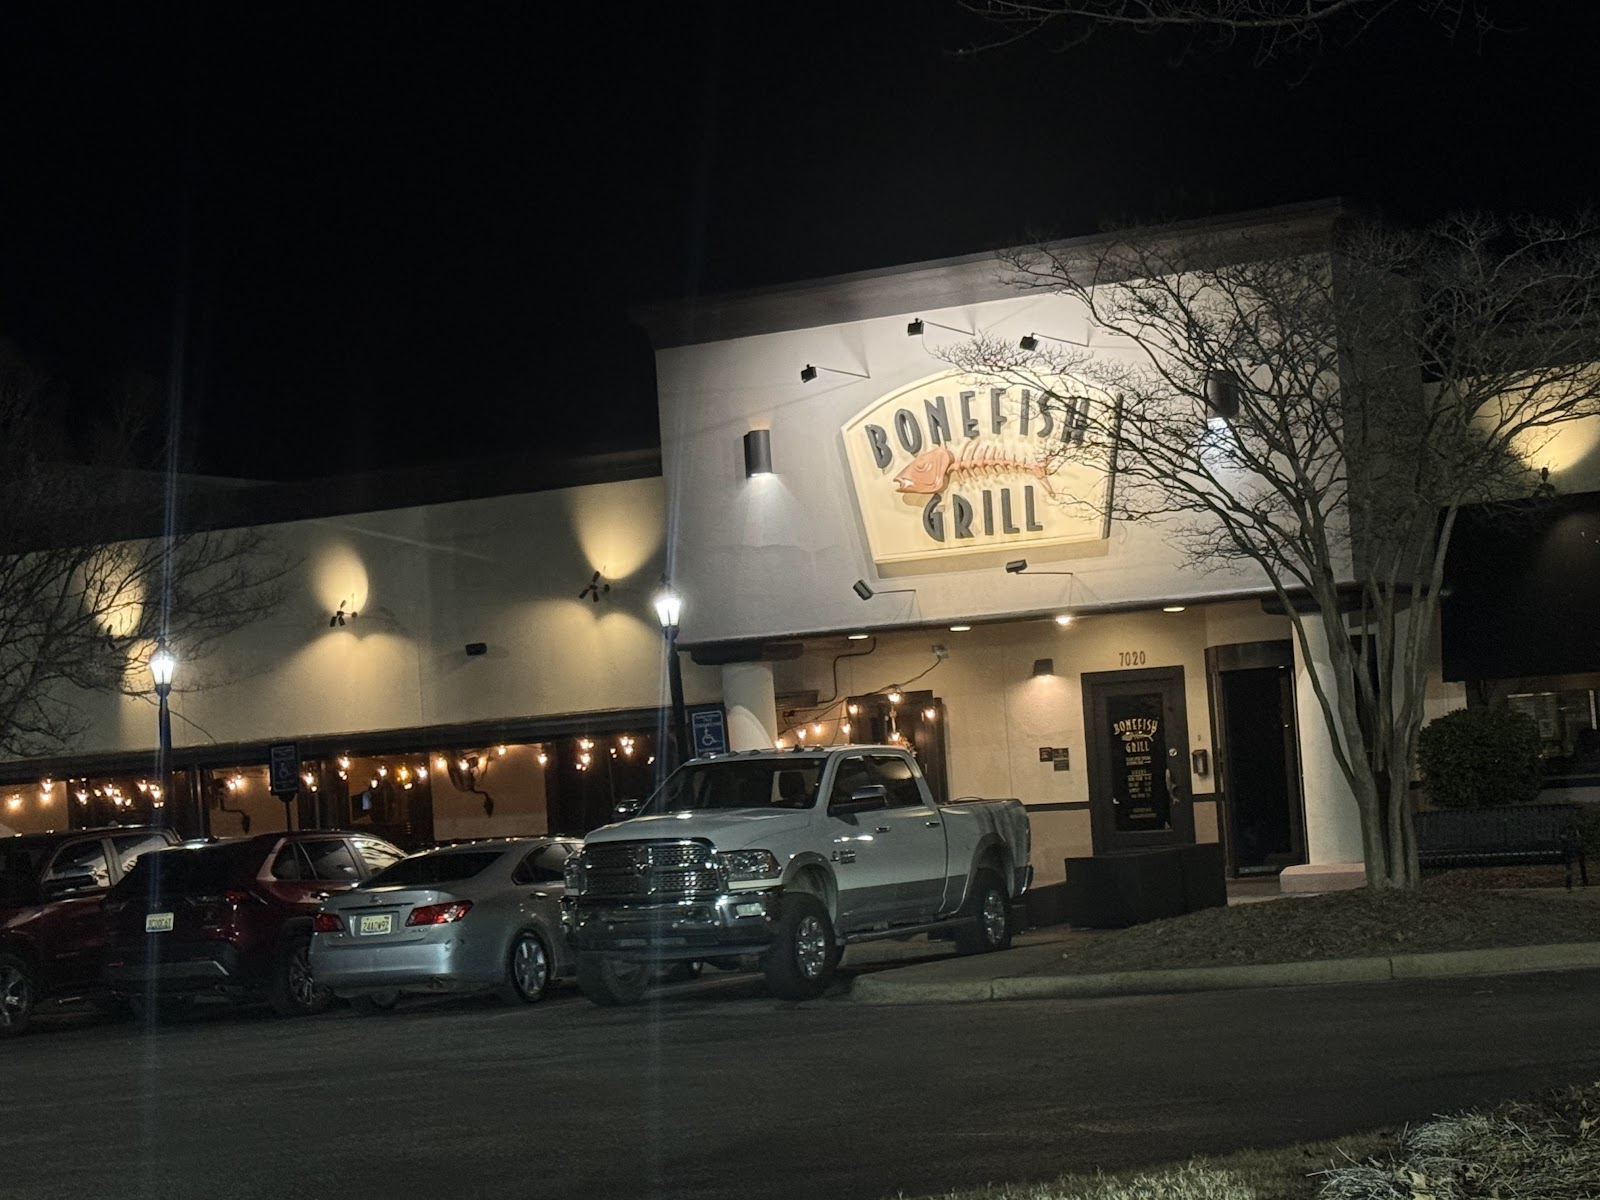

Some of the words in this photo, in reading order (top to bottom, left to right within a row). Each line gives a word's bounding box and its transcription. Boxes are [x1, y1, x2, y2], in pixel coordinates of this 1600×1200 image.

[865, 387, 1090, 470] BONEFISH
[923, 485, 1043, 542] GRILL
[1119, 651, 1146, 667] 7020
[1113, 718, 1159, 735] BONEFISH
[1125, 741, 1150, 753] GRILL
